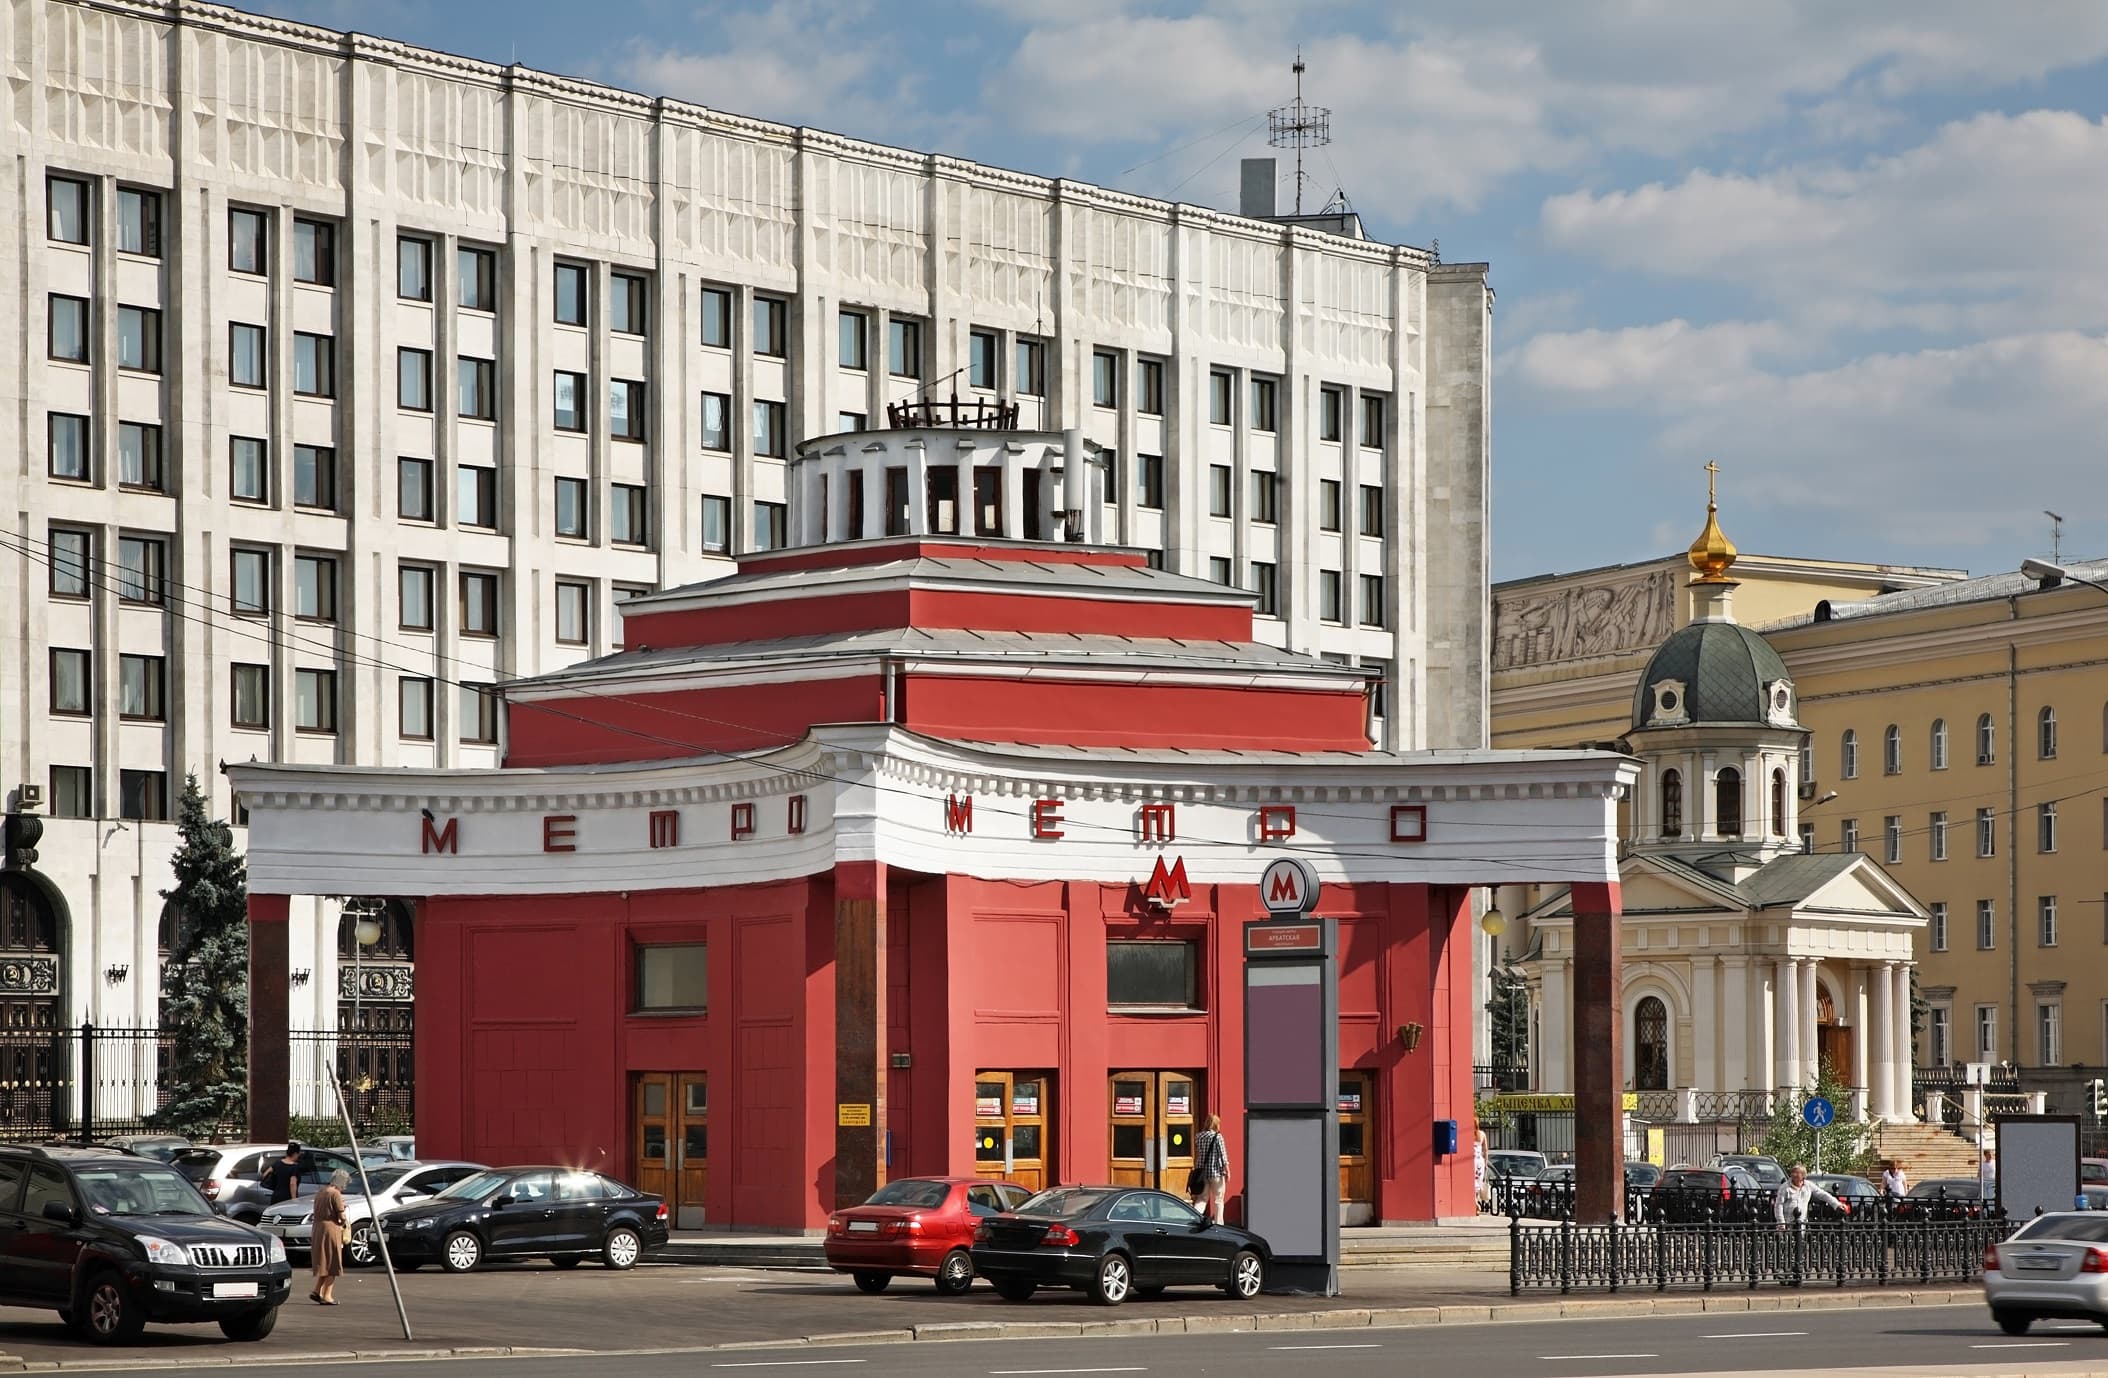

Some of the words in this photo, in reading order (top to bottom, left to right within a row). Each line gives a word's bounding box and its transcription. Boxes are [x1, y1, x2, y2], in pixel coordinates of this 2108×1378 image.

[421, 794, 807, 854] МЕТРО
[949, 795, 1427, 844] МЕТРО
[1147, 855, 1192, 899] М
[1269, 870, 1298, 901] М
